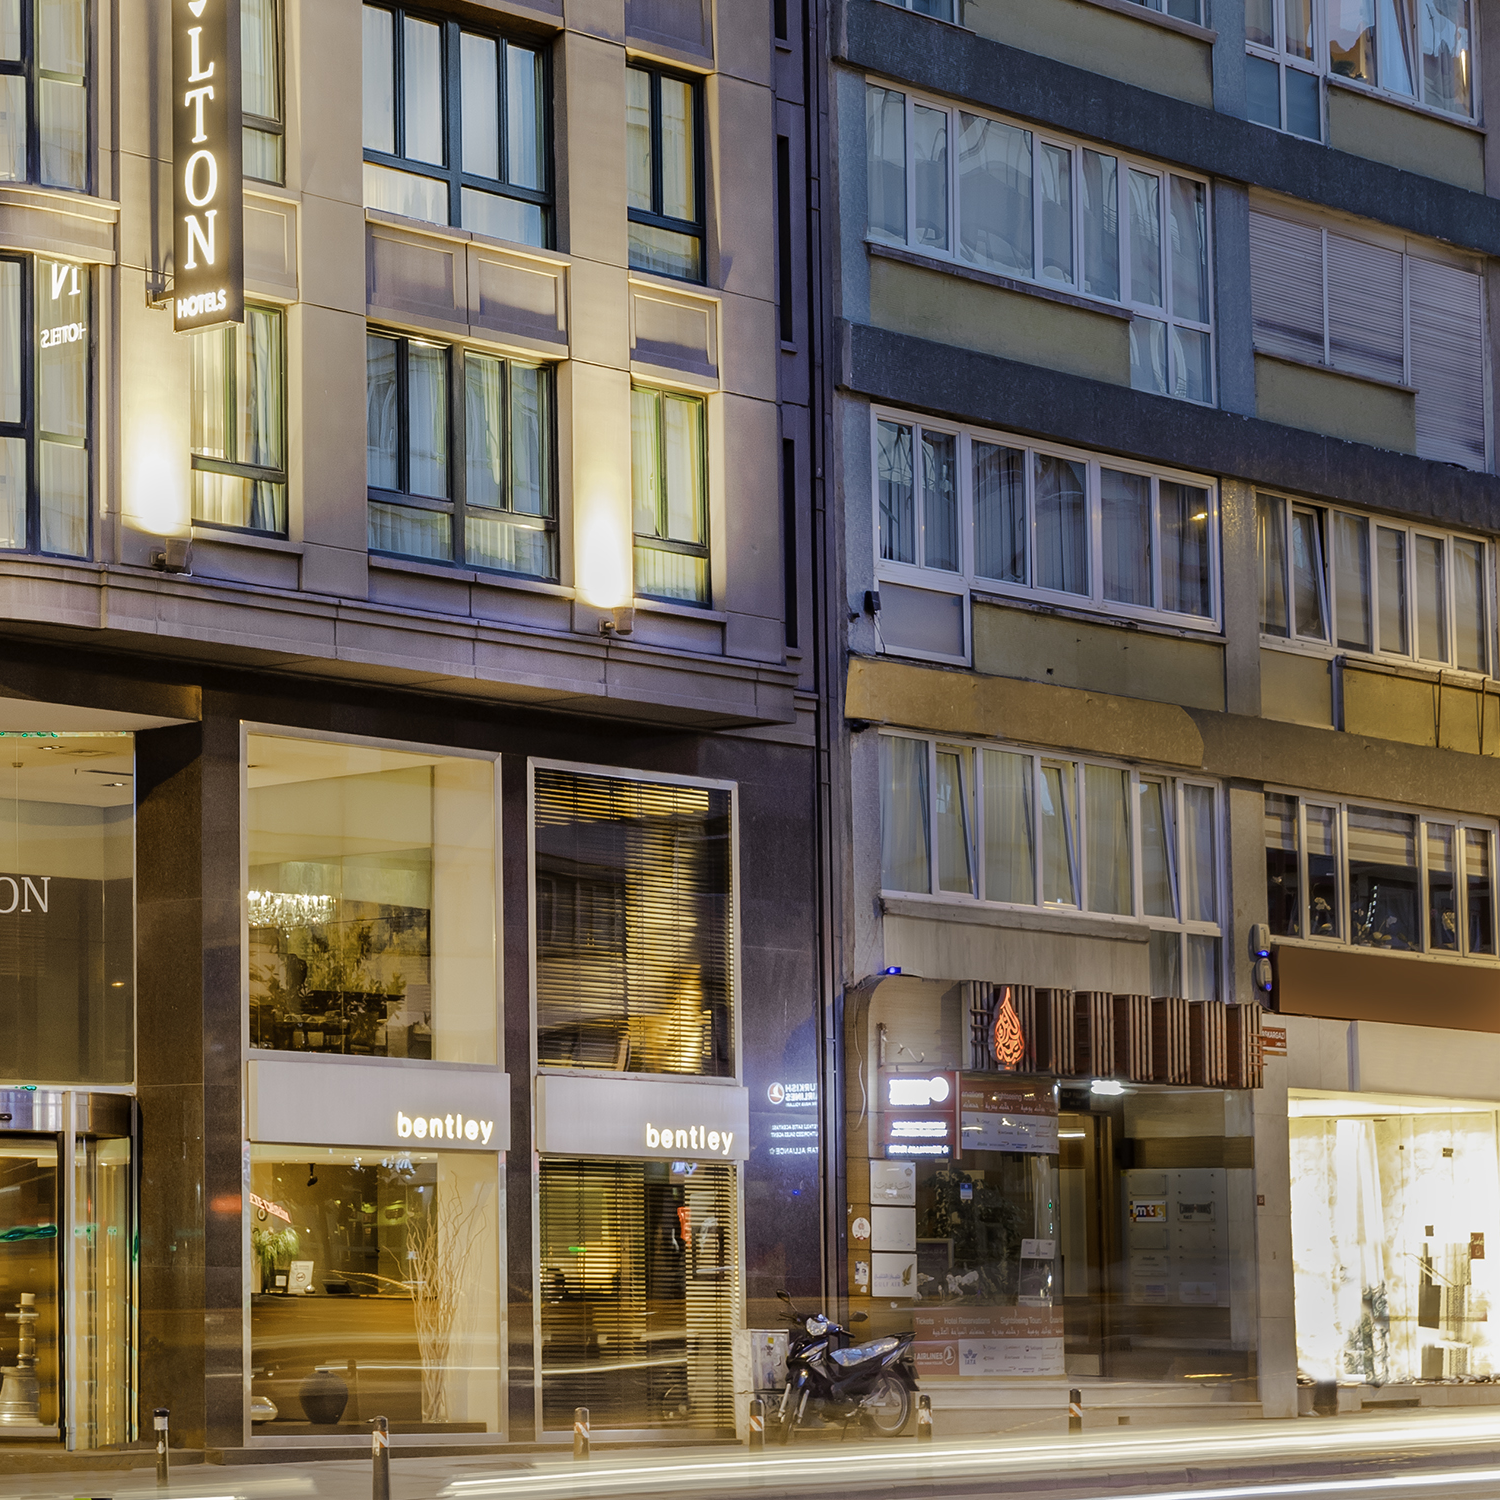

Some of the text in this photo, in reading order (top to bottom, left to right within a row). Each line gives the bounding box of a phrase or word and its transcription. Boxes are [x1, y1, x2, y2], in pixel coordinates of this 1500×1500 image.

[176, 288, 228, 319] HOTELS
[397, 1110, 494, 1146] bentley
[645, 1122, 734, 1156] bentley
[915, 1317, 935, 1325] Tickets
[944, 1317, 958, 1325] Hotel
[958, 1317, 991, 1325] Reservations
[916, 1351, 944, 1360] AIRLINES
